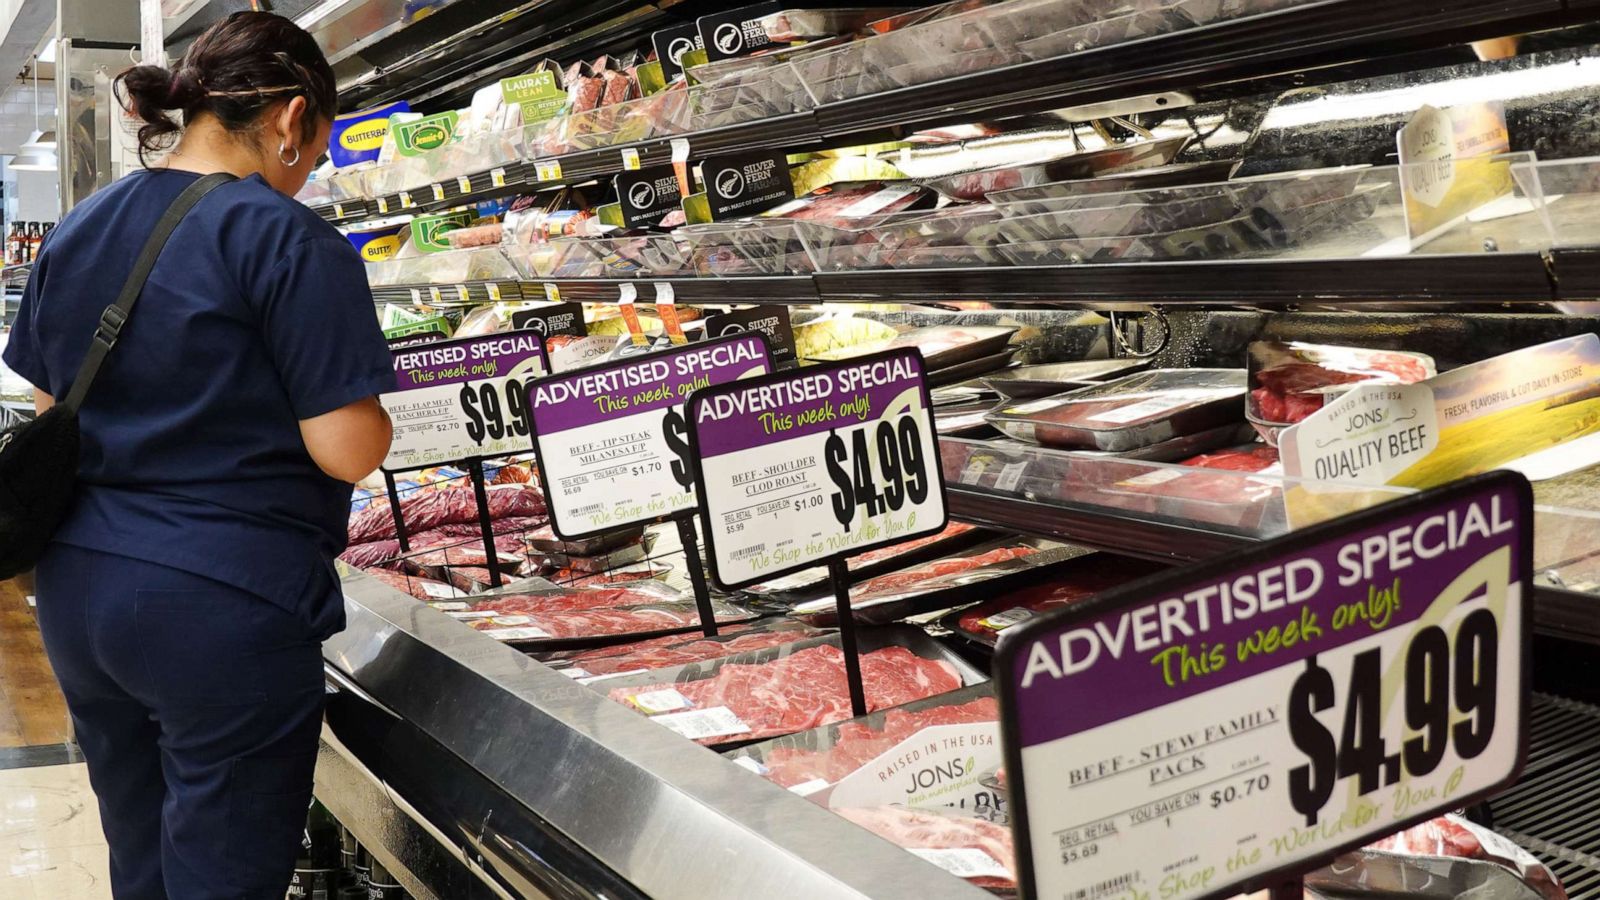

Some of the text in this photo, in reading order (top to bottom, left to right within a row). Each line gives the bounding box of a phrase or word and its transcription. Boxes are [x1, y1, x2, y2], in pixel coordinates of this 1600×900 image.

[506, 75, 550, 91] LAURA'S
[516, 87, 543, 98] LEAN
[743, 159, 775, 175] SILVER
[745, 169, 772, 184] FERN
[748, 177, 780, 192] FARMS
[547, 313, 574, 324] SILVER
[548, 321, 570, 331] FERN
[748, 316, 779, 331] SILVER
[471, 336, 539, 359] SPECIAL
[582, 347, 606, 359] JONS
[408, 359, 498, 385] This week only!
[534, 340, 764, 409] ADVERTISED SPECIAL
[594, 394, 629, 415] This
[633, 383, 674, 406] week
[698, 357, 918, 424] ADVERTISED SPECIAL
[1444, 402, 1470, 420] FRESH,
[1471, 389, 1510, 411] FLAVORFUL
[1511, 388, 1518, 397] &
[1518, 384, 1531, 396] CUT
[1532, 376, 1552, 392] DAILY
[389, 404, 407, 414] BEEF
[432, 398, 453, 407] MEAT
[460, 374, 533, 447] $9.9
[758, 393, 872, 436] This week only!
[1328, 400, 1355, 422] RAISED
[1370, 392, 1384, 401] THE
[1387, 391, 1402, 401] USA
[437, 422, 459, 432] $2.70
[1345, 407, 1383, 432] JONS
[570, 442, 596, 455] BEEF
[603, 437, 618, 448] TIP
[619, 430, 651, 444] STEAK
[580, 446, 631, 465] MILANESA
[1315, 438, 1382, 480] QUALITY
[1388, 424, 1426, 459] BEEF
[632, 461, 662, 477] $1.70
[732, 470, 756, 485] BEEF
[764, 456, 815, 475] SHOULDER
[824, 415, 928, 533] $4.99
[746, 481, 773, 495] CLOD
[775, 471, 806, 487] ROAST
[589, 511, 611, 526] We
[614, 505, 642, 520] Shop
[647, 499, 665, 512] the
[757, 499, 790, 514] YOU SAVE ON
[795, 494, 823, 511] $1.00
[726, 523, 744, 534] $5.99
[749, 552, 770, 571] We
[773, 547, 800, 565] Shop
[805, 541, 825, 556] the
[827, 529, 862, 551] World
[866, 525, 881, 540] for
[884, 517, 904, 540] You
[1021, 495, 1514, 688] ADVERTISED SPECIAL
[1151, 578, 1402, 688] This week only!
[1288, 608, 1498, 827] $4.99
[878, 734, 993, 782] RAISED IN THE USA
[1069, 754, 1124, 786] BEEF
[1139, 731, 1199, 761] STEW
[1203, 705, 1279, 743] FAMILY
[906, 758, 964, 794] JONS
[1150, 751, 1206, 783] PACK
[1210, 774, 1270, 809] $0.70
[1129, 790, 1201, 825] YOU SAVE ON
[1085, 820, 1118, 840] RETAIL
[1158, 866, 1215, 900] Shop
[1225, 849, 1263, 878] the
[1269, 811, 1348, 857] World
[1351, 802, 1384, 829] for
[1392, 786, 1436, 820] You
[1062, 844, 1099, 865] $5.69
